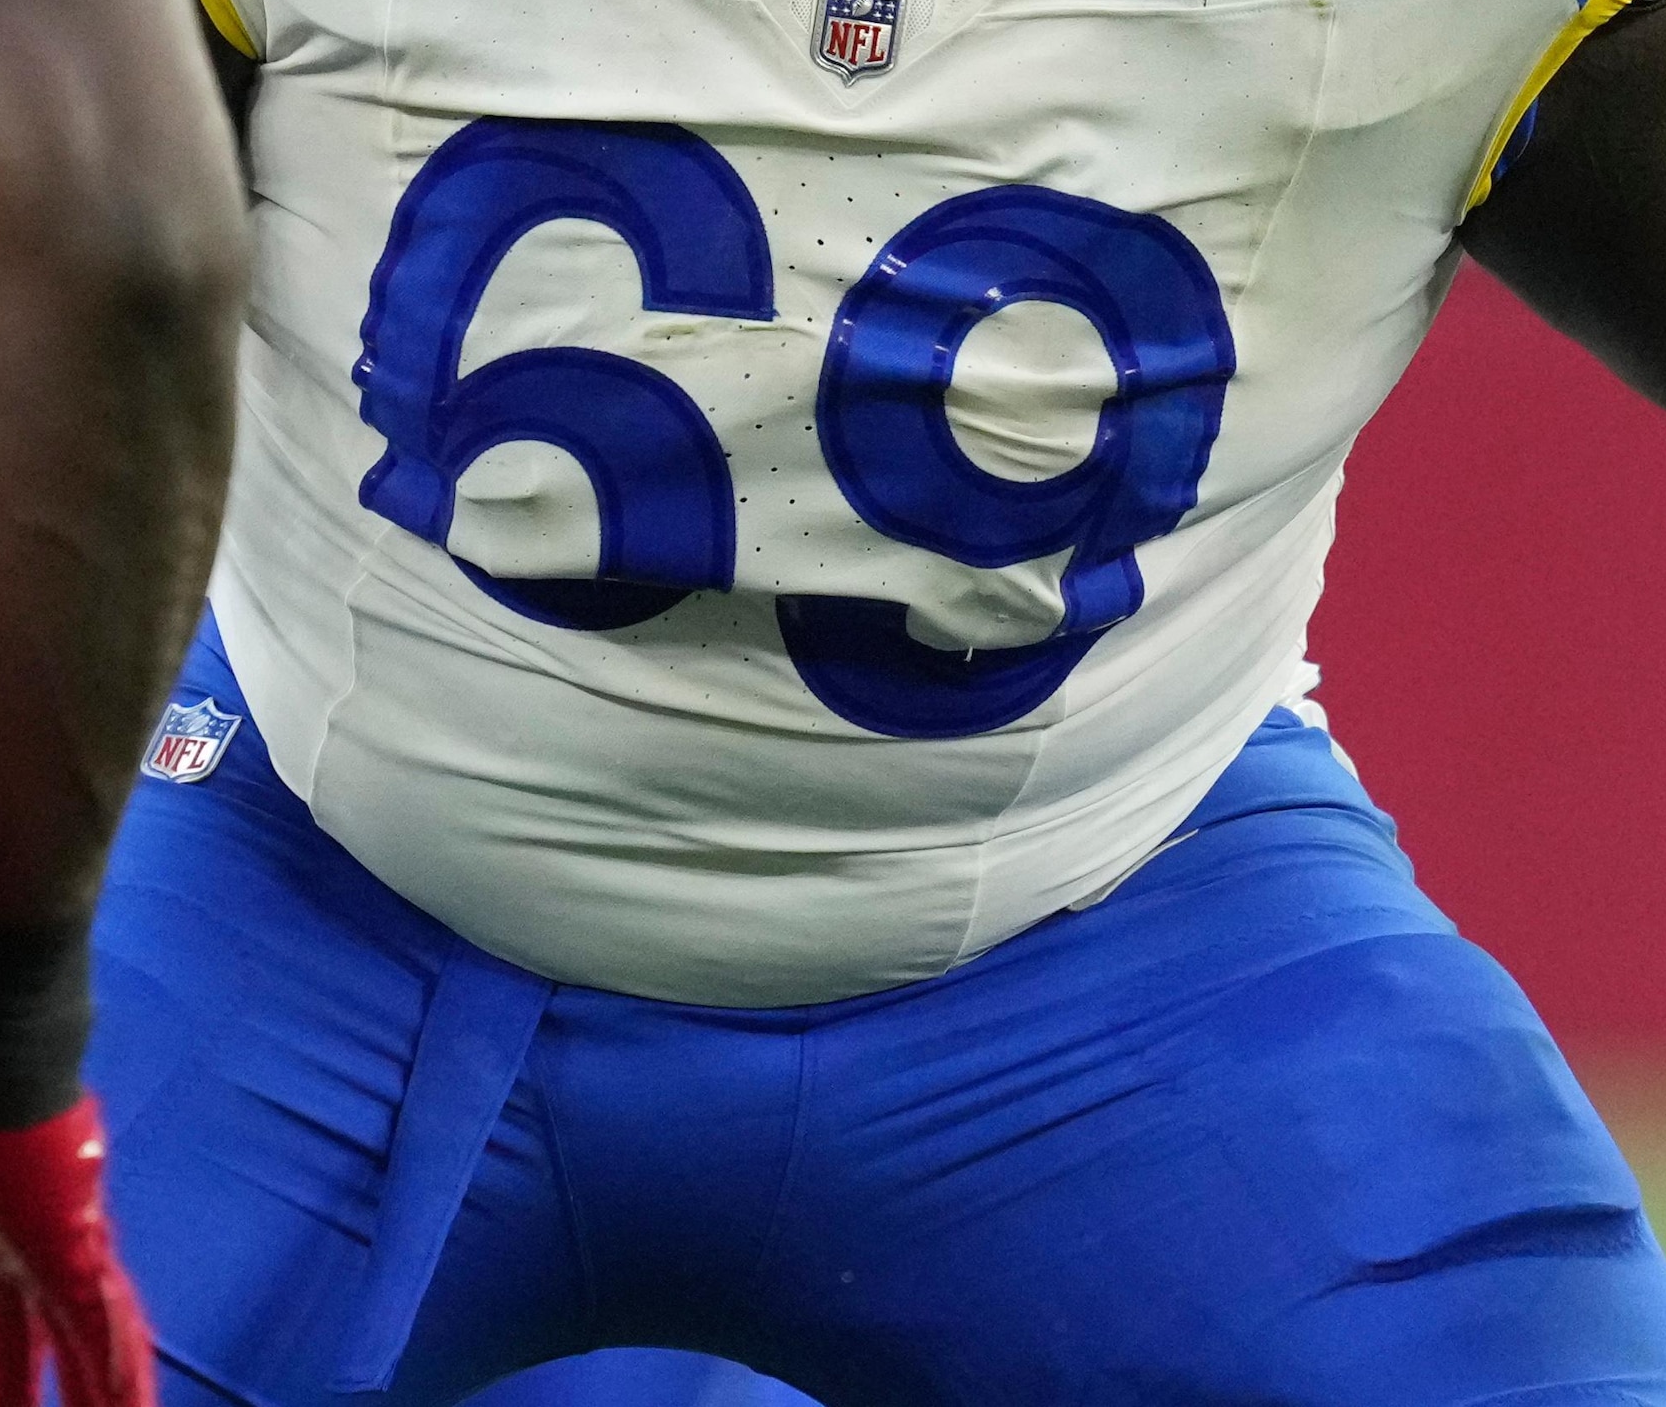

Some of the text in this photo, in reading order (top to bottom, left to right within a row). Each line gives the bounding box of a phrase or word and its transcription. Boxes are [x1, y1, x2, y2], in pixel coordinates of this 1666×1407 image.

[826, 20, 885, 66] NFL
[351, 115, 1238, 738] 69
[154, 736, 211, 772] NFL
